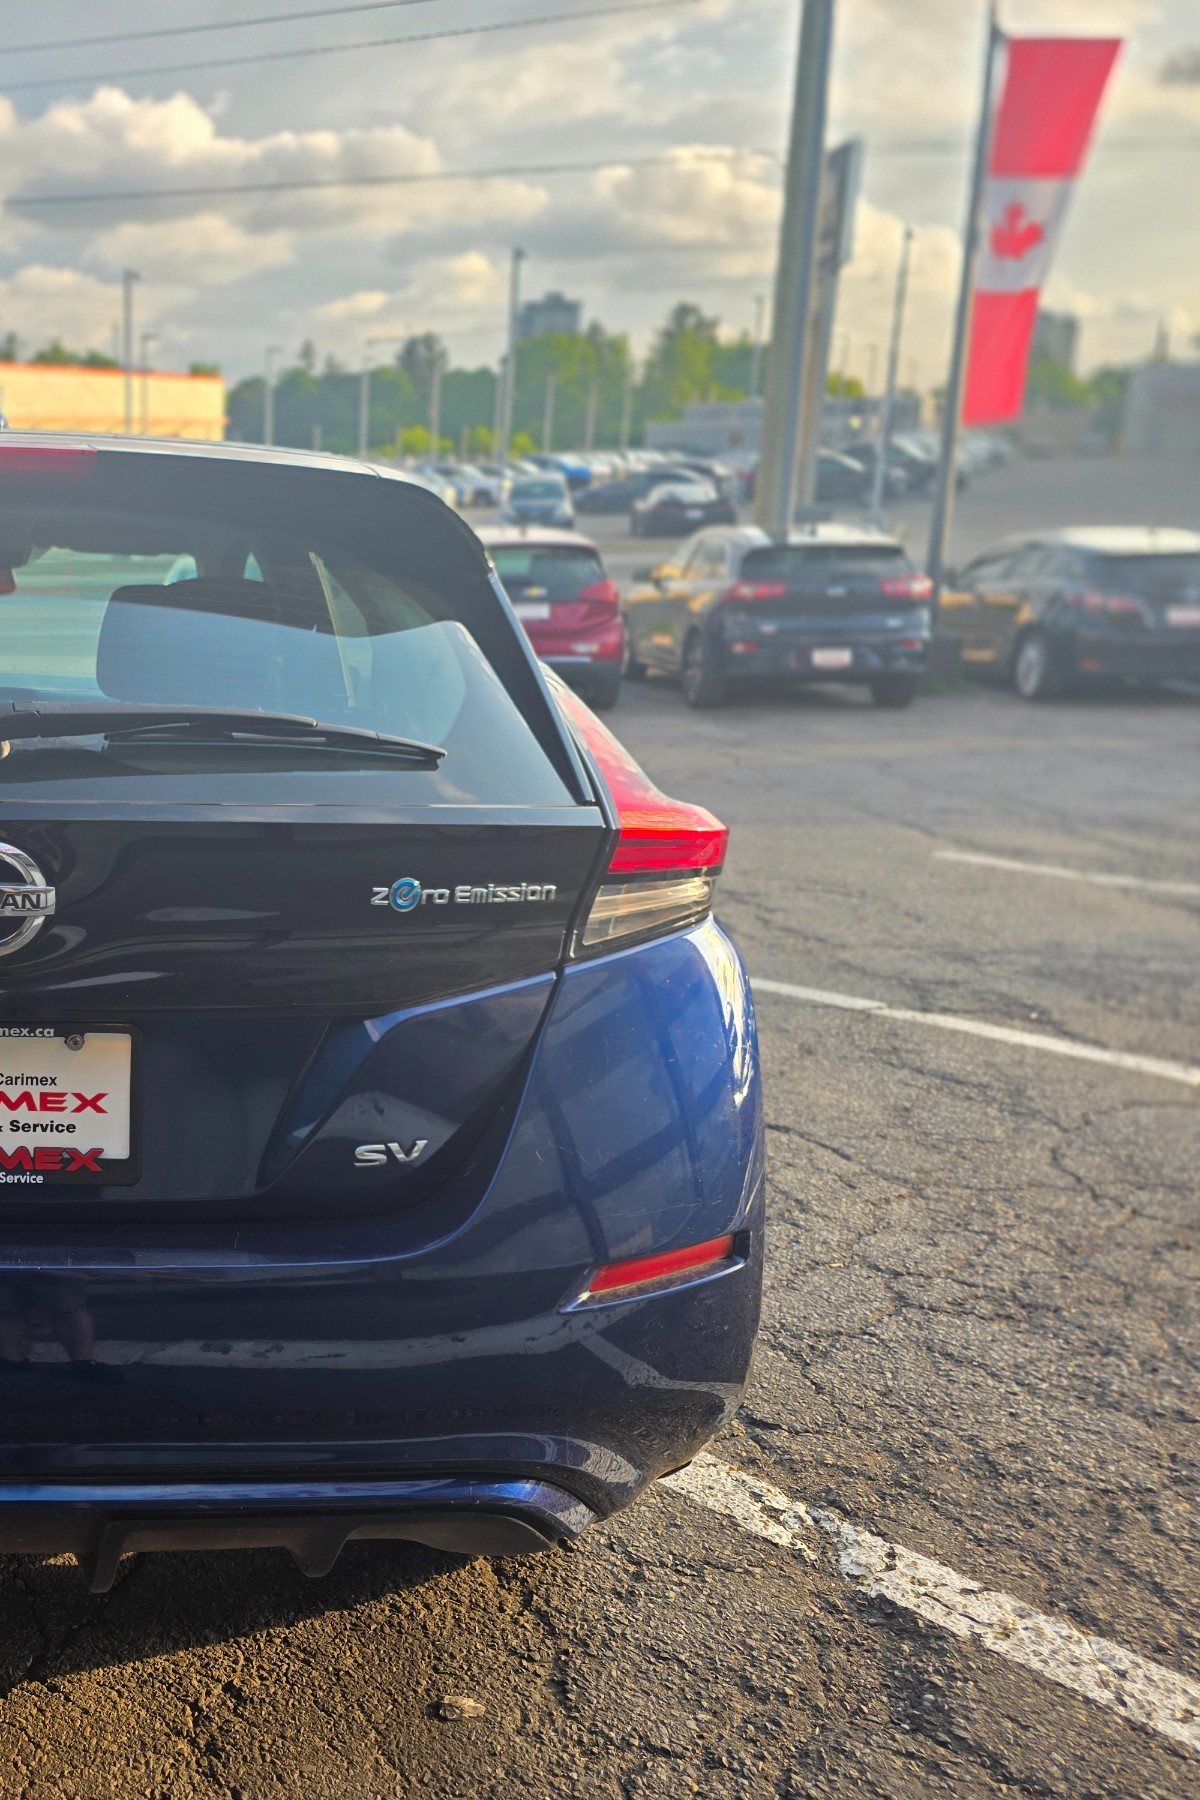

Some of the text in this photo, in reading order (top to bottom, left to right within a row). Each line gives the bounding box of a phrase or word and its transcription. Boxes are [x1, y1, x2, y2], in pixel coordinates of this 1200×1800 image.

[454, 883, 557, 904] Emission
[9, 1120, 77, 1133] Service
[353, 1140, 428, 1166] SV
